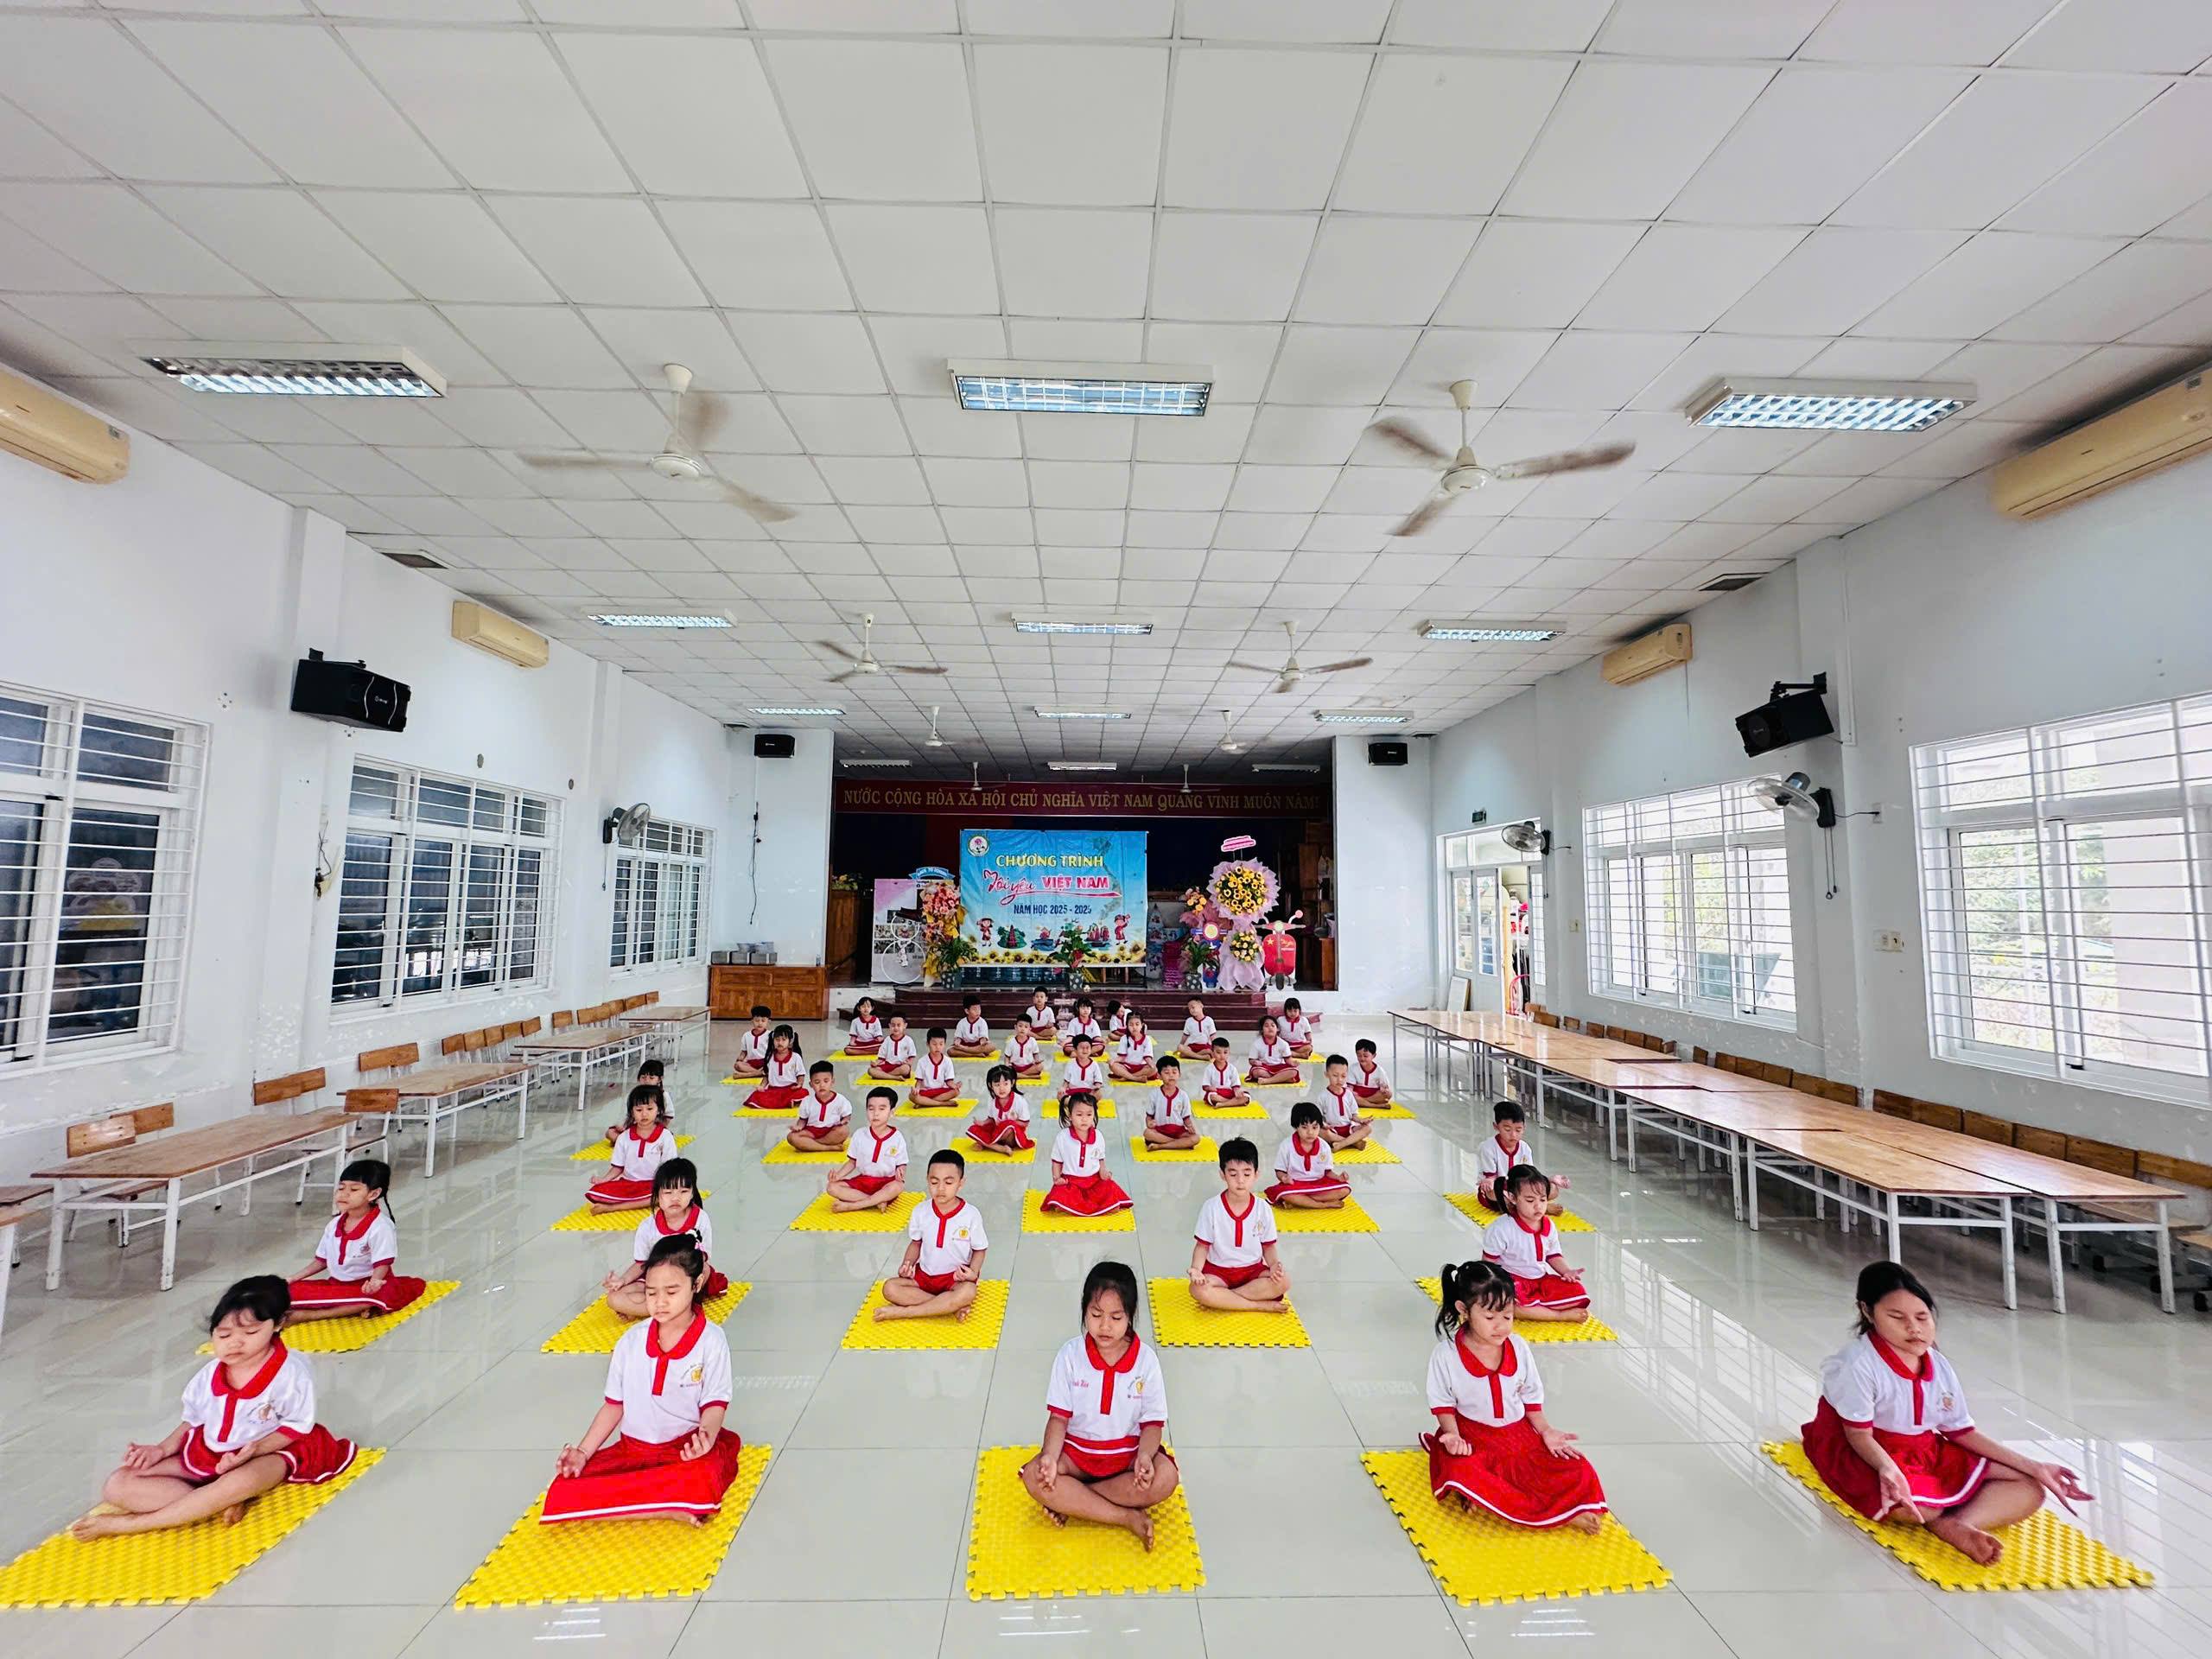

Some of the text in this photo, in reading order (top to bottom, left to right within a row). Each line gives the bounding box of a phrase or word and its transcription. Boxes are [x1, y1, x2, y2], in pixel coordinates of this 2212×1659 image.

[844, 787, 880, 804] NƯỚC
[885, 788, 922, 807] CỘNG
[926, 788, 955, 806] HÒA
[982, 790, 1006, 809] HỘI
[1010, 788, 1038, 807] CHỦ
[1042, 791, 1085, 807] NGHĨA
[1089, 791, 1120, 810] VIỆT
[1124, 794, 1153, 808] NAM
[1158, 794, 1203, 810] QUANG
[1207, 795, 1239, 809] VINH
[995, 852, 1103, 868] CHƯƠNG TRÌNH
[983, 869, 1009, 892] Tôi
[1042, 874, 1072, 891] VIỆT
[1077, 876, 1109, 889] NAM
[1033, 904, 1048, 916] HỌC
[1051, 904, 1067, 914] 2025
